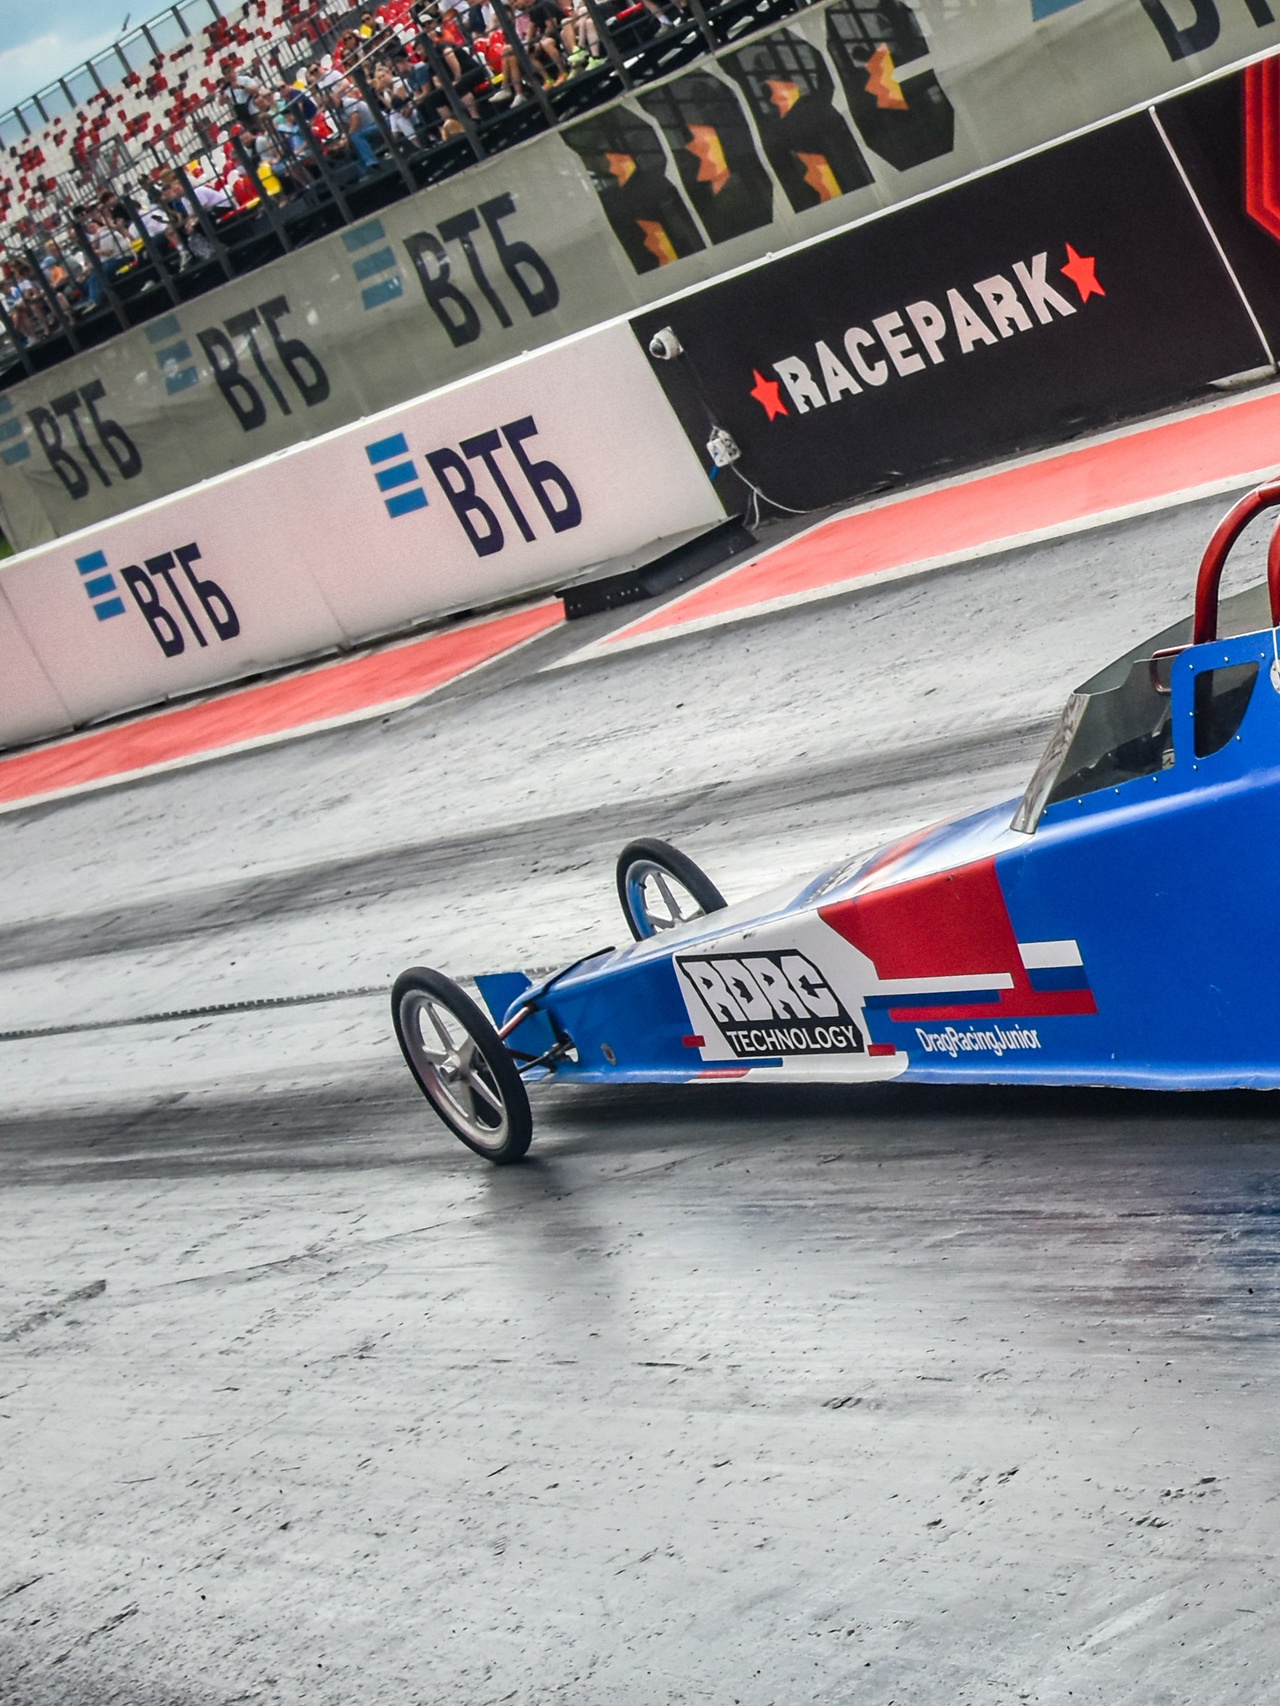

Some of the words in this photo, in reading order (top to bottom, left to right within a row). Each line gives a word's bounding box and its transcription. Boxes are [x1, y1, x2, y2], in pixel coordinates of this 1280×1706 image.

[557, 0, 955, 276] RDRC
[402, 191, 561, 348] ВТБ
[772, 251, 1077, 414] RACEPARK
[196, 295, 331, 432] ВТБ
[27, 378, 143, 501] ВТБ
[425, 415, 583, 558] ВТБ
[120, 541, 241, 658] ВТБ
[681, 955, 840, 1024] RDRC
[726, 1025, 858, 1053] TECHNOLOGY
[914, 1023, 1042, 1058] DragRacingJunior
